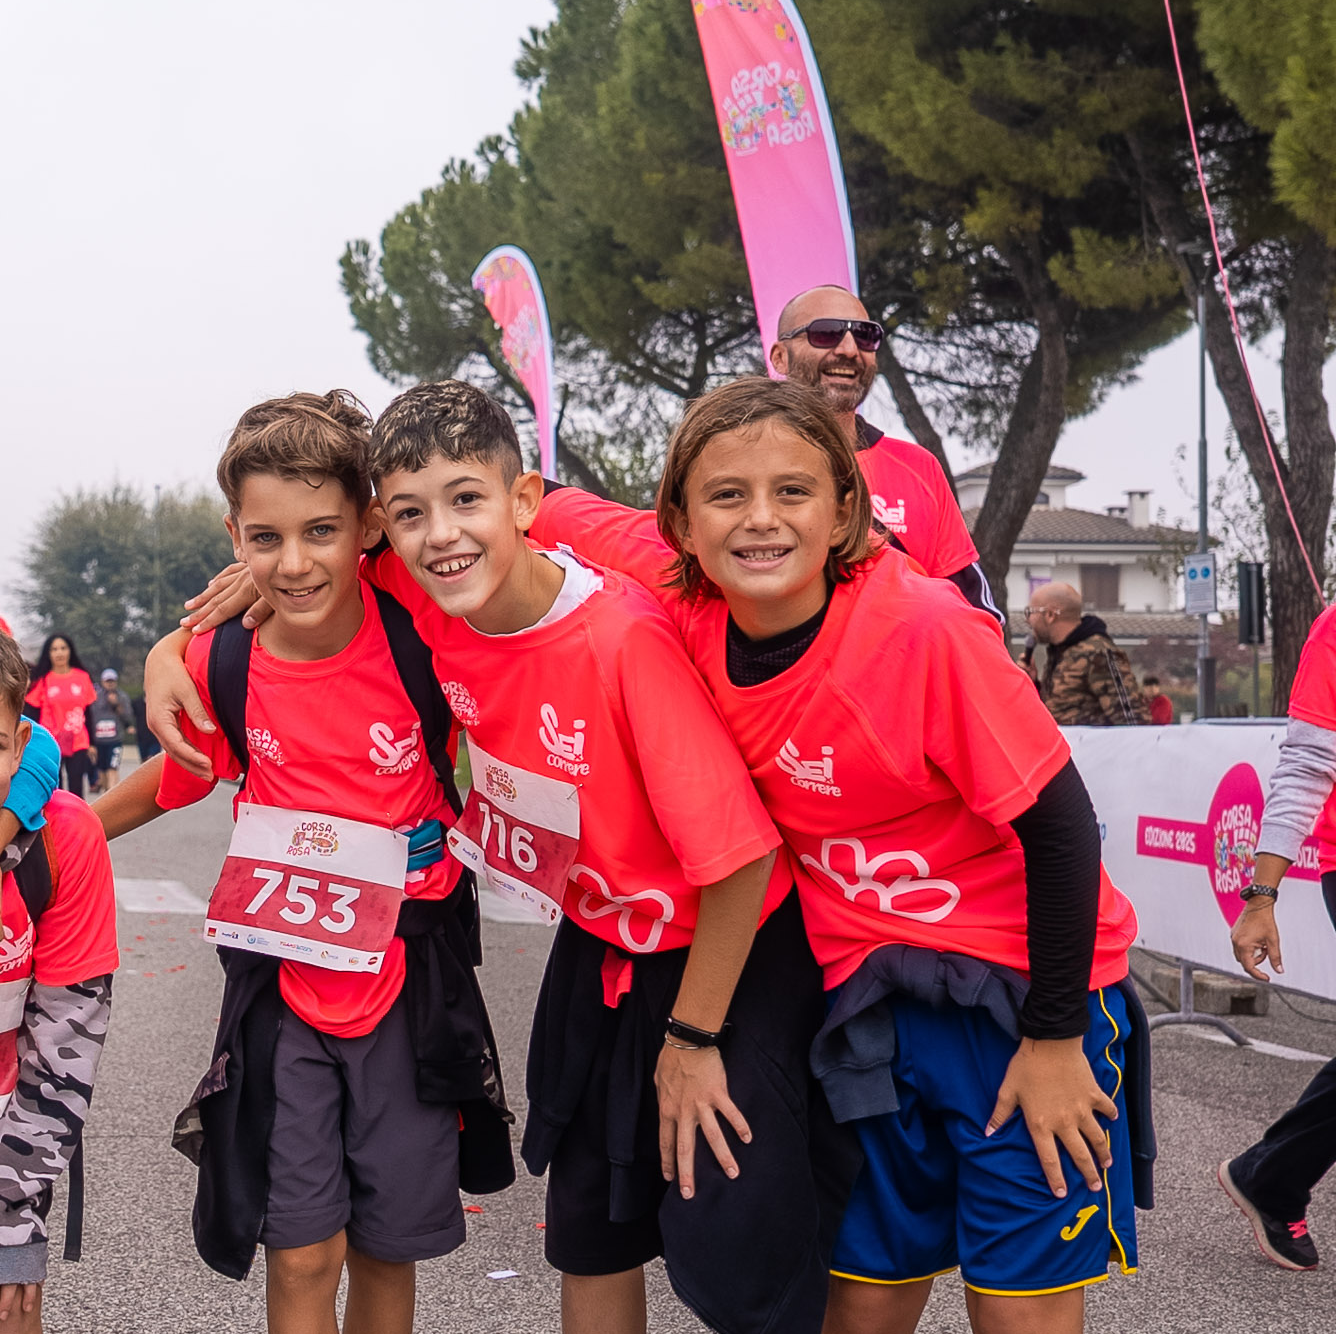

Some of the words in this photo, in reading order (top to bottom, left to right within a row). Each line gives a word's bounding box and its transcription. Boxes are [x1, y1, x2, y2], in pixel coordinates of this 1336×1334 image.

[547, 753, 590, 776] correre
[789, 775, 842, 798] correre
[301, 822, 332, 833] CORSA
[1221, 804, 1252, 831] CORSA
[286, 845, 311, 857] ROSA
[478, 802, 538, 873] 116
[1144, 825, 1175, 849] EDIZIONE
[1175, 833, 1196, 854] 2025
[1215, 867, 1242, 894] ROSA
[243, 867, 361, 934] 753
